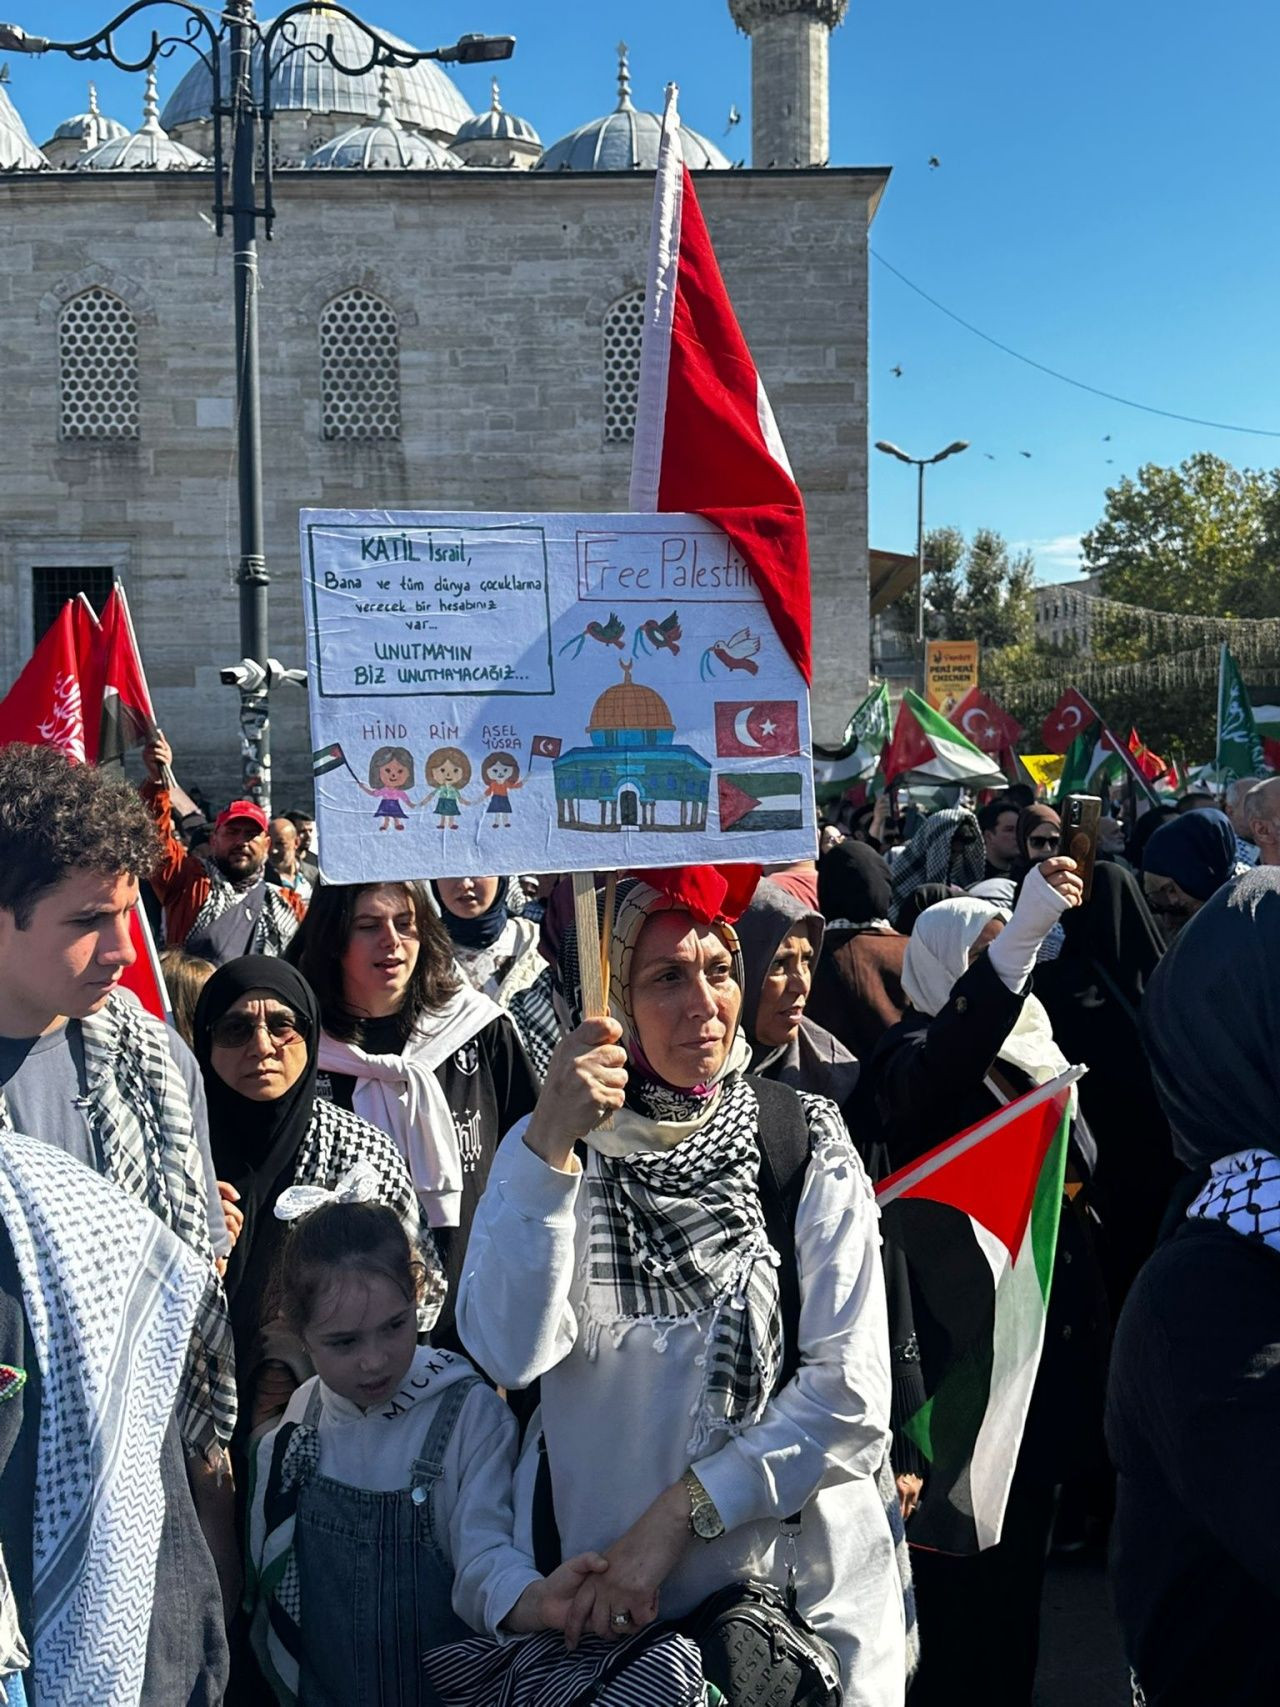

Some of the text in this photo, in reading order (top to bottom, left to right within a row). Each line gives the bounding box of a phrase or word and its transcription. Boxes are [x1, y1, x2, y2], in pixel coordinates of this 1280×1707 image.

[361, 532, 472, 567] KATİL İsrail,
[585, 539, 753, 591] Free Palestin
[324, 571, 362, 590] Bana
[376, 580, 391, 590] ve
[399, 575, 425, 591] tüm
[434, 575, 471, 597] dünya
[355, 598, 497, 613] verecek bir hesabınız
[374, 642, 472, 661] UNUTMAYIN
[354, 664, 386, 686] BİZ
[362, 720, 408, 740] HİND
[429, 721, 459, 740] RİM
[482, 724, 518, 738] ASEL
[382, 1350, 455, 1420] MICKE
